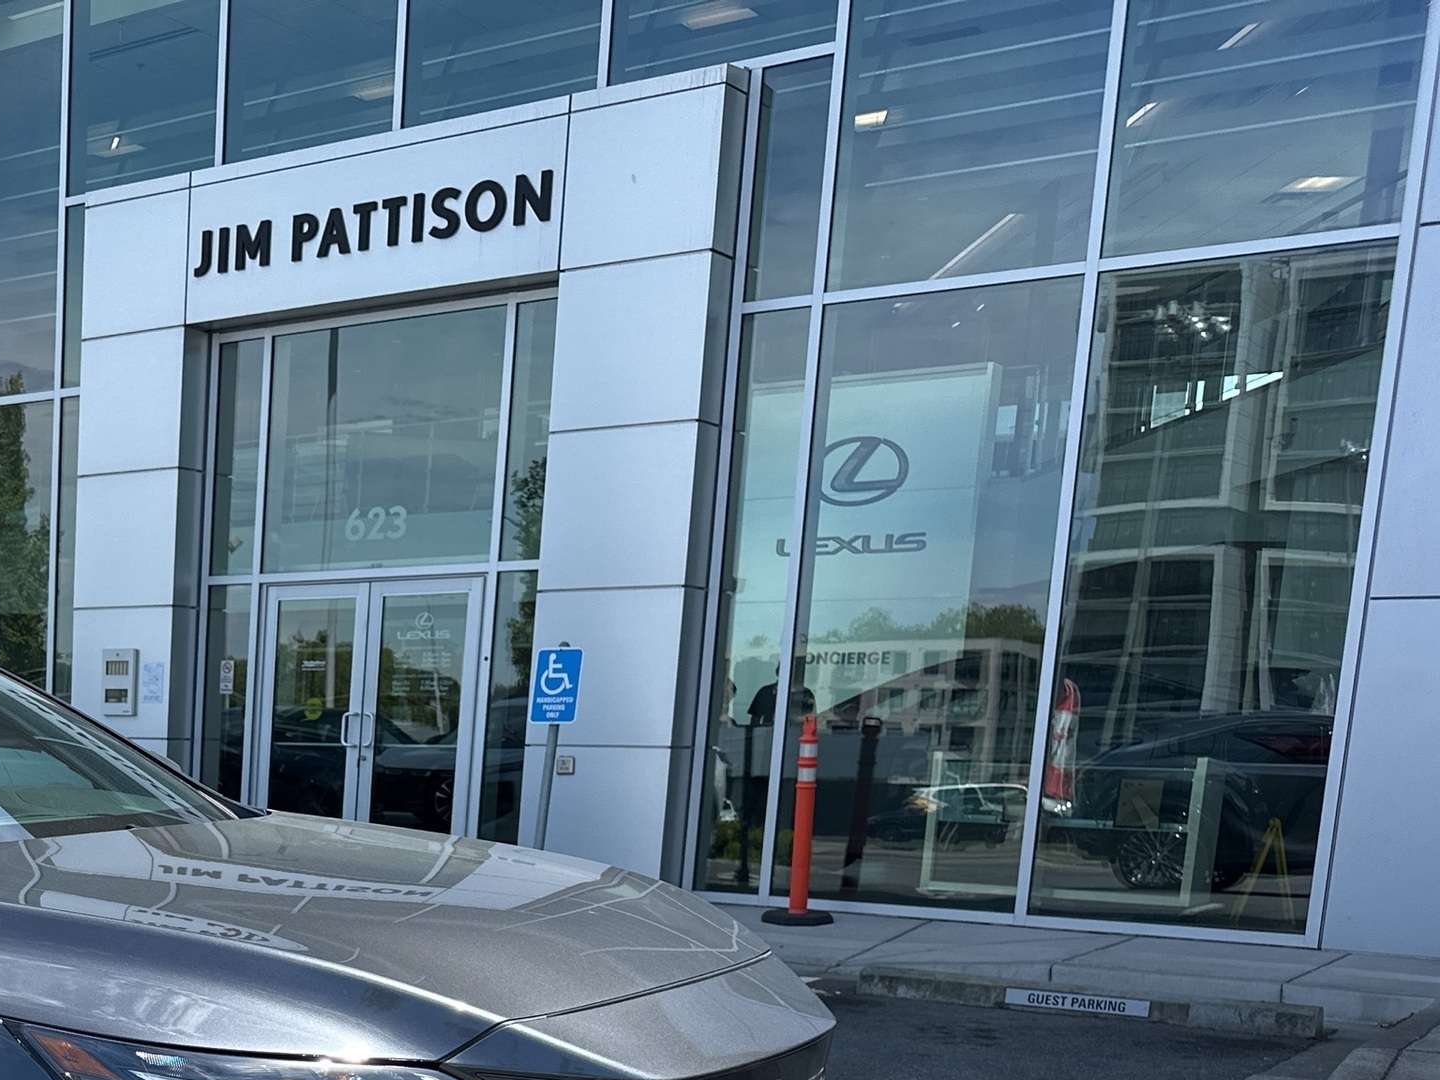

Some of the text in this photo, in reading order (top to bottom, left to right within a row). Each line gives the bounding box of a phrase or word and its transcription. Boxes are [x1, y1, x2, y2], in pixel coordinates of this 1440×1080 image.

[194, 169, 554, 278] JIM PATTISON
[345, 505, 407, 541] 623
[776, 532, 927, 557] LEXUS
[397, 630, 450, 640] LEXUS
[806, 651, 890, 665] ONCIERGE
[1027, 993, 1127, 1013] GUEST PARKING
